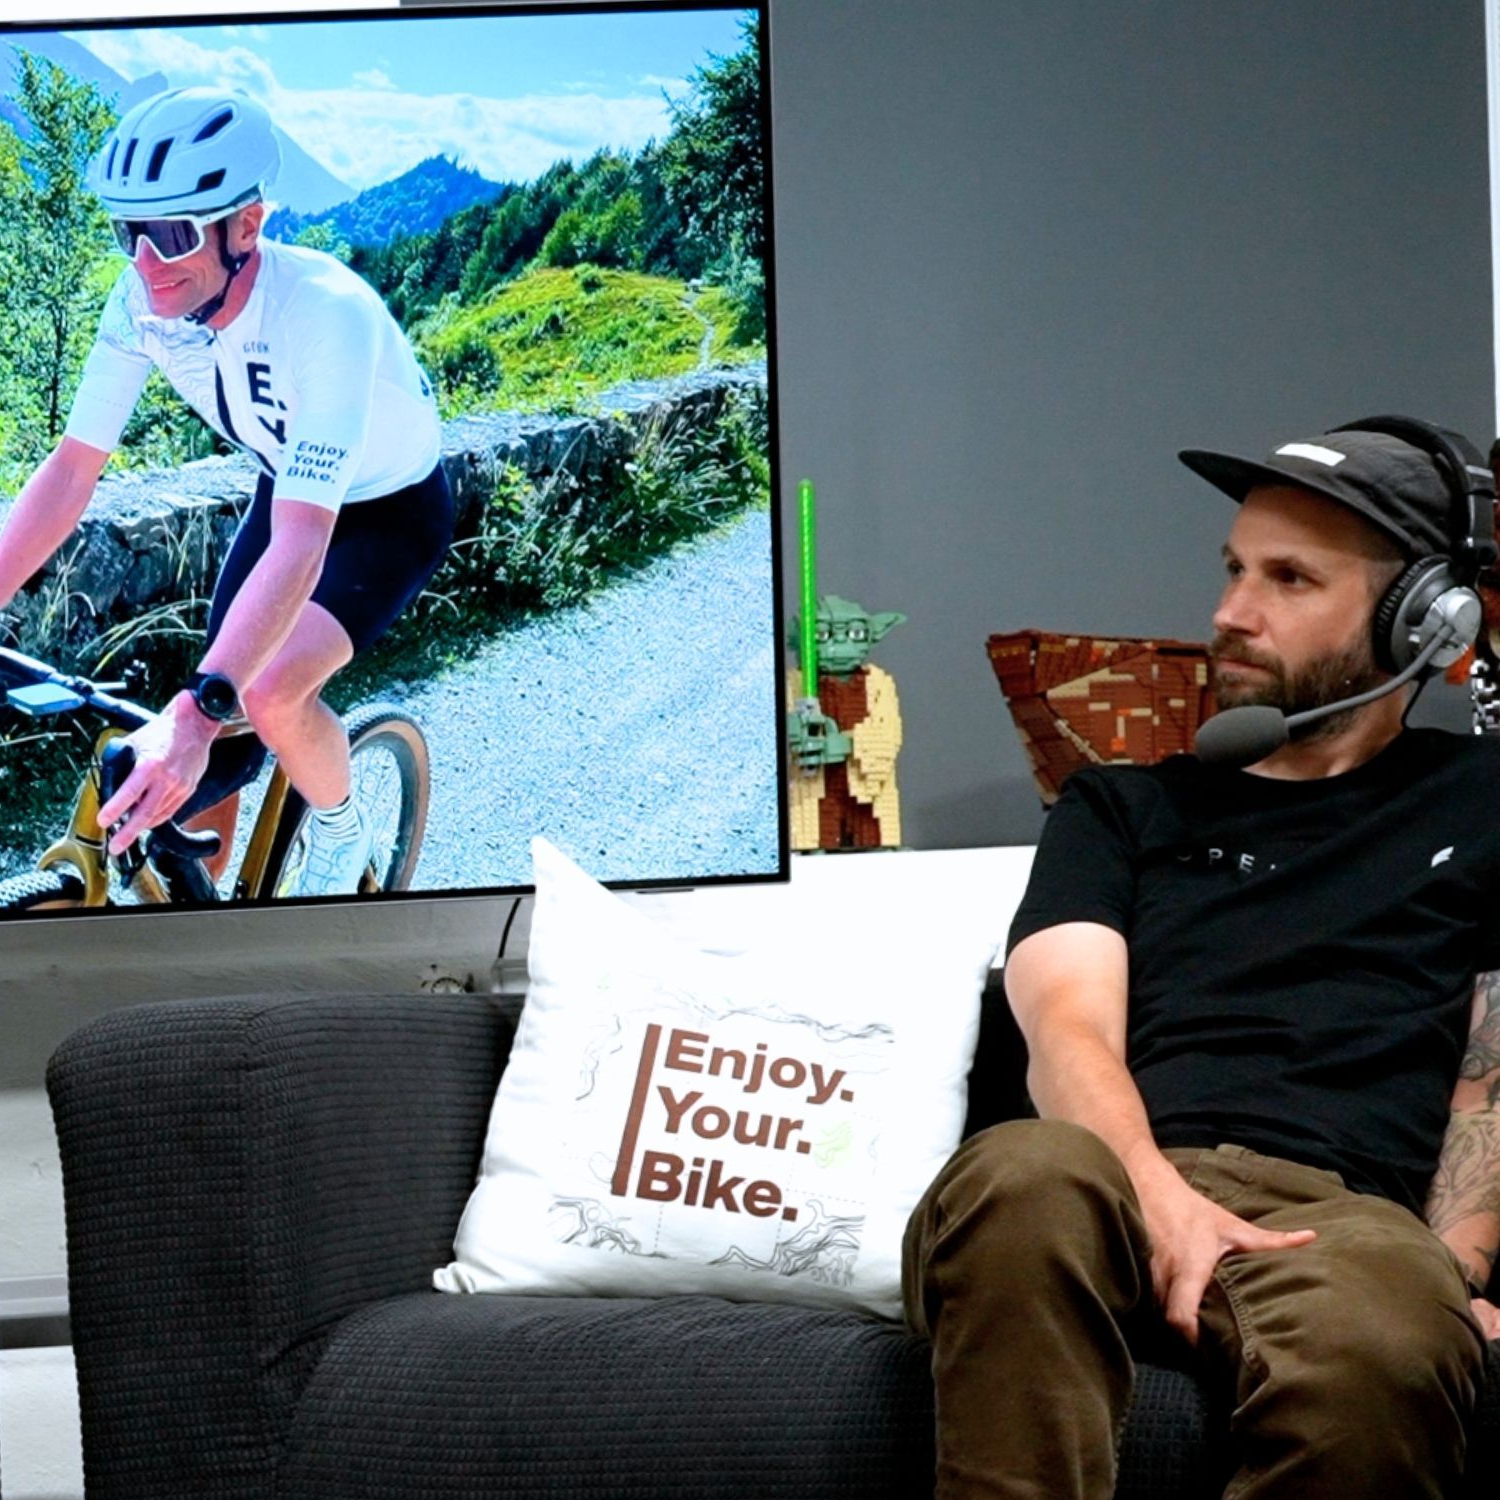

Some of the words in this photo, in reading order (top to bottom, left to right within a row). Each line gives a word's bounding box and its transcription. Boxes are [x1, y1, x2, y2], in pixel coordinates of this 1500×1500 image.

[294, 454, 340, 471] Your.
[296, 440, 350, 460] Enjoy.
[286, 466, 336, 484] Bike.
[663, 1028, 855, 1106] Enjoy.
[656, 1085, 812, 1156] Your.
[635, 1149, 799, 1223] Bike.
